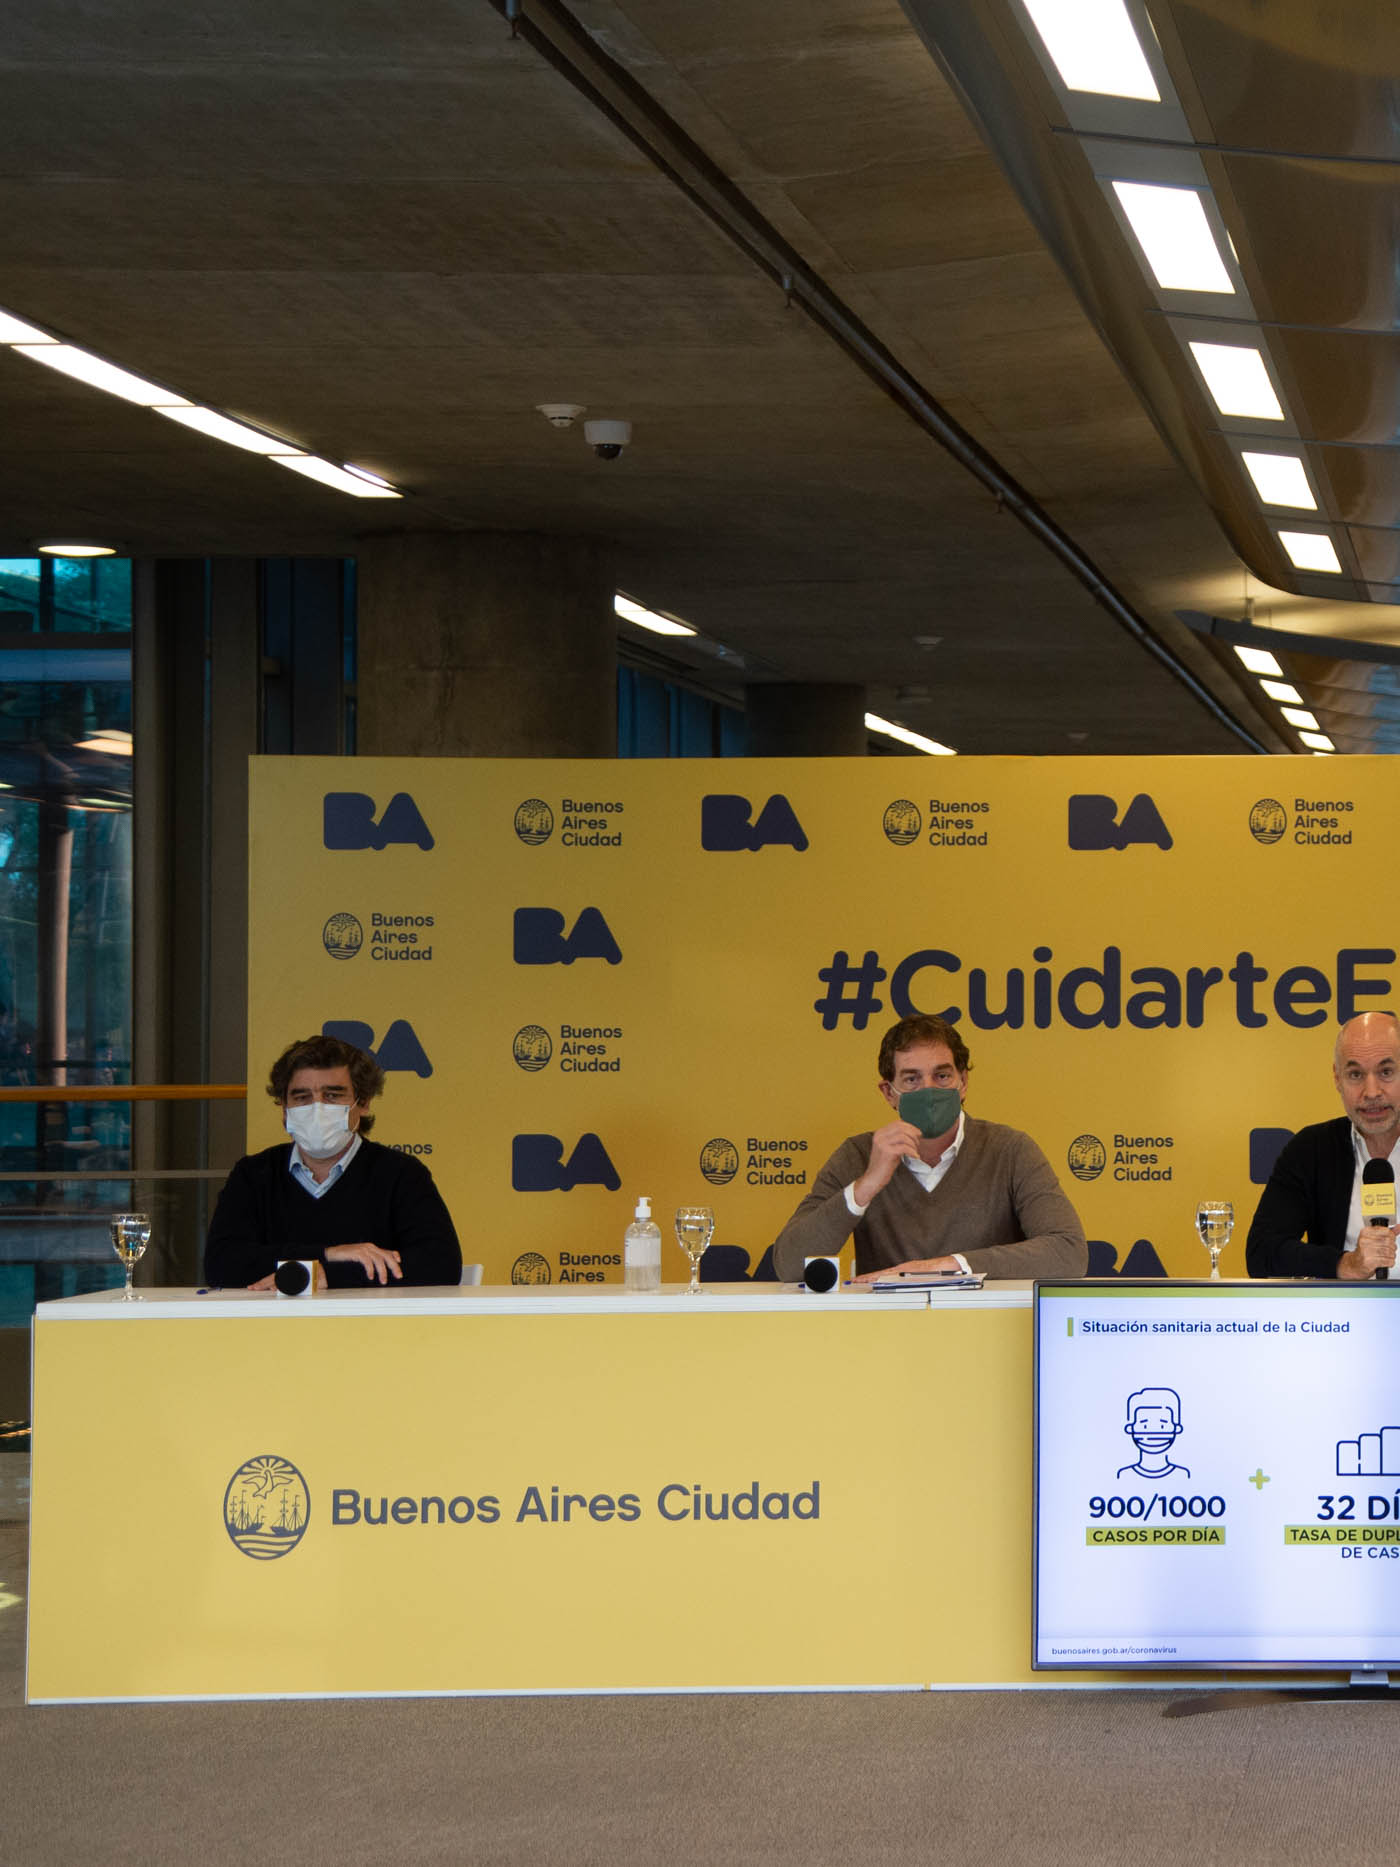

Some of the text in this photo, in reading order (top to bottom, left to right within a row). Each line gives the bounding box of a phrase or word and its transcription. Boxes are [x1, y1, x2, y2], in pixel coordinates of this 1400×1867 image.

[562, 800, 623, 813] Buenos
[930, 800, 989, 813] Buenos
[1295, 799, 1354, 812] Buenos
[324, 792, 435, 851] BA
[562, 816, 607, 829] Aires
[701, 794, 809, 852] BA
[929, 816, 973, 829] Aires
[1068, 794, 1173, 851] BA
[1295, 815, 1338, 828] Aires
[562, 832, 621, 846] Ciudad
[929, 832, 987, 846] Ciudad
[1295, 831, 1352, 844] Ciudad
[372, 913, 434, 926] Buenos
[371, 930, 417, 943] Aires
[513, 907, 622, 965] BA
[371, 946, 432, 960] Ciudad
[561, 1025, 622, 1038] Buenos
[560, 1042, 606, 1055] Aires
[560, 1058, 620, 1072] Ciudad
[747, 1138, 808, 1151] Buenos
[1114, 1135, 1173, 1147] Buenos
[512, 1133, 622, 1192] BA
[747, 1155, 792, 1168] Aires
[1114, 1151, 1158, 1164] Aires
[747, 1170, 806, 1185] Ciudad
[1114, 1167, 1171, 1181] Ciudad
[560, 1252, 621, 1265] Buenos
[559, 1269, 605, 1283] Aires
[1083, 1321, 1349, 1332] Situación sanitaria actual de la Ciudad
[333, 1481, 819, 1525] Buenos Aires Ciudad
[1089, 1494, 1225, 1521] 900/1000
[1317, 1496, 1355, 1520] 32
[1093, 1526, 1220, 1542] CASOS POR DÍA
[1290, 1529, 1331, 1541] TASA
[1336, 1529, 1357, 1541] DE
[1342, 1547, 1362, 1558] DE
